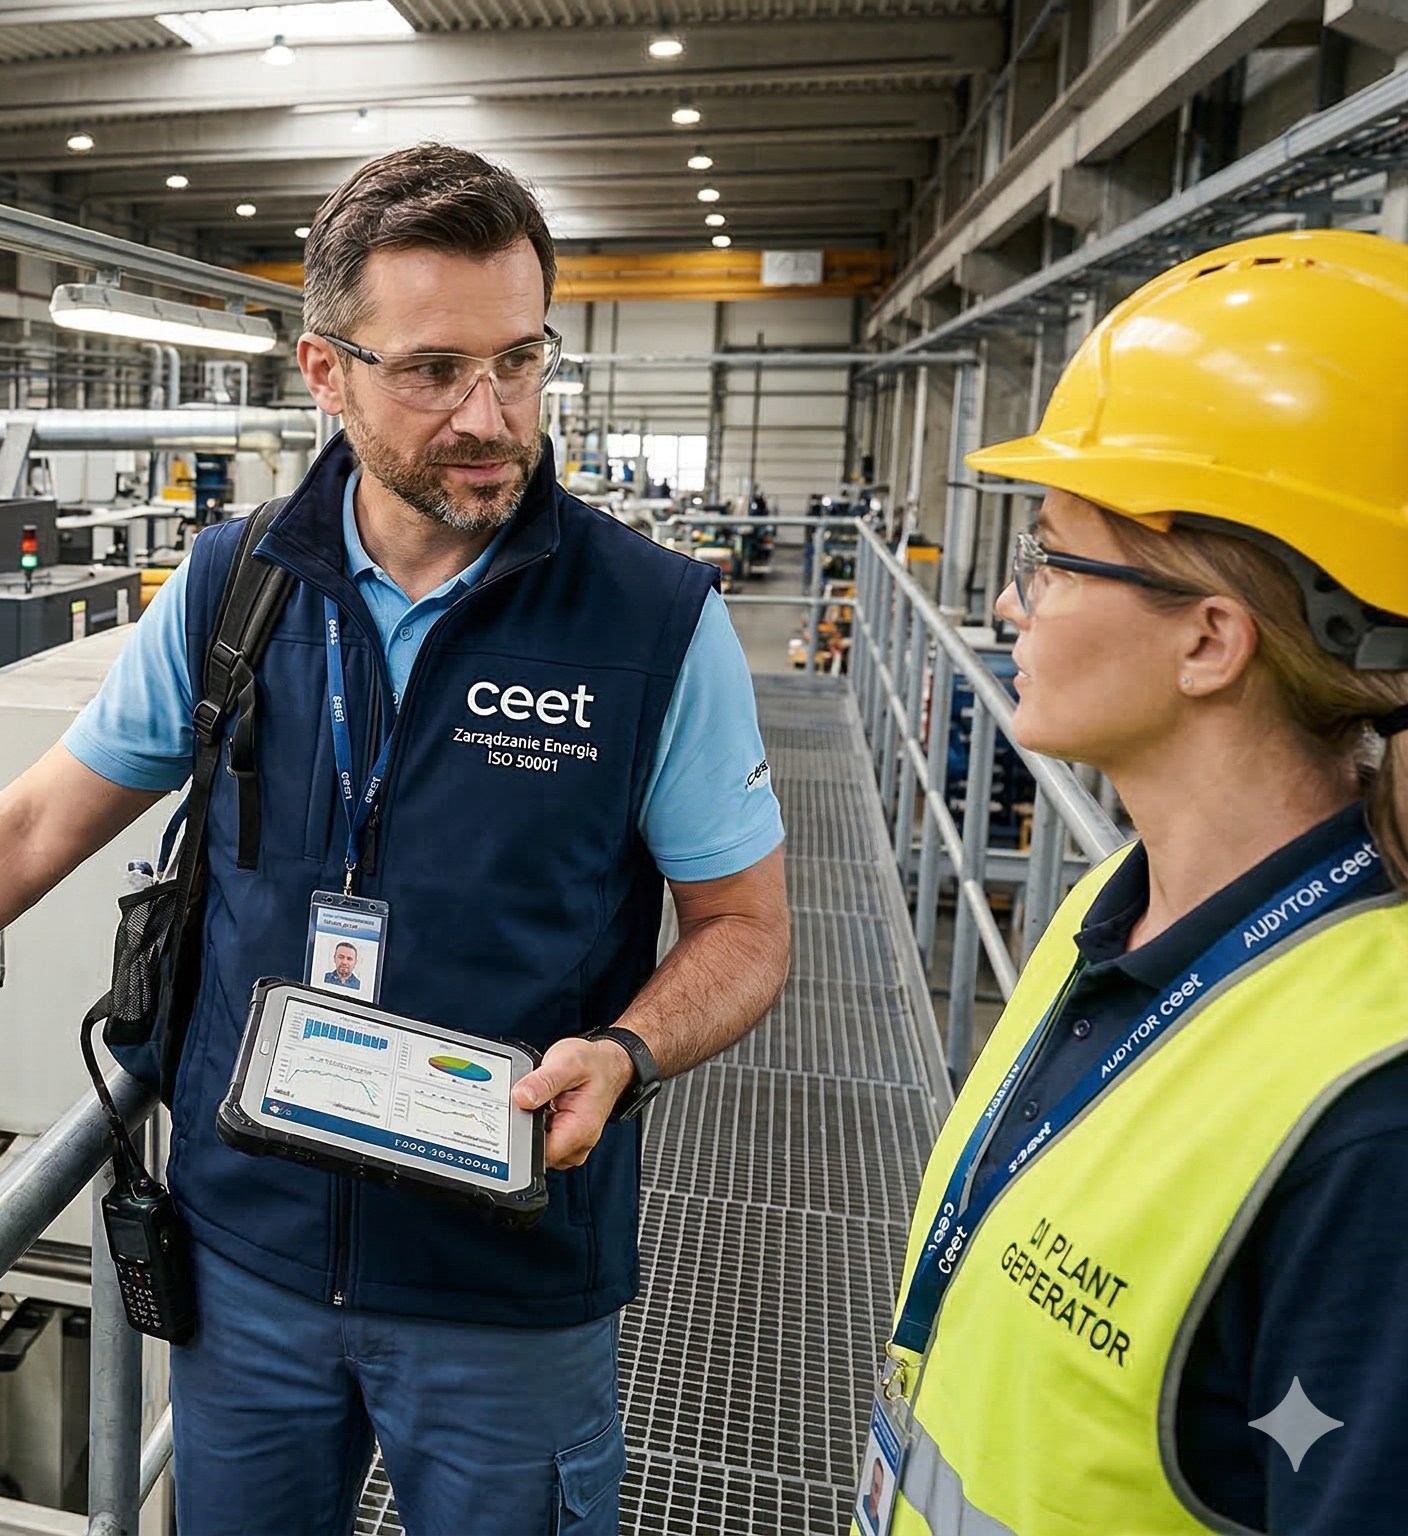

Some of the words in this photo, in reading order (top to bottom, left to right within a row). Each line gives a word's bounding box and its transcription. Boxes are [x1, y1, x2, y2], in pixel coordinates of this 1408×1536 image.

[467, 681, 595, 728] ceet
[453, 727, 541, 749] Zarządzanie
[544, 738, 598, 761] Energią
[487, 750, 513, 767] ISO
[515, 754, 559, 772] 50001
[1242, 879, 1329, 949] AUDYTOR
[1329, 842, 1381, 885] ceet
[1101, 1014, 1161, 1079] AUDYTOR
[1160, 972, 1204, 1017] ceet
[938, 1225, 968, 1275] ceet
[1044, 1233, 1128, 1308] PLANT
[1001, 1242, 1131, 1368] GEPERATOR
